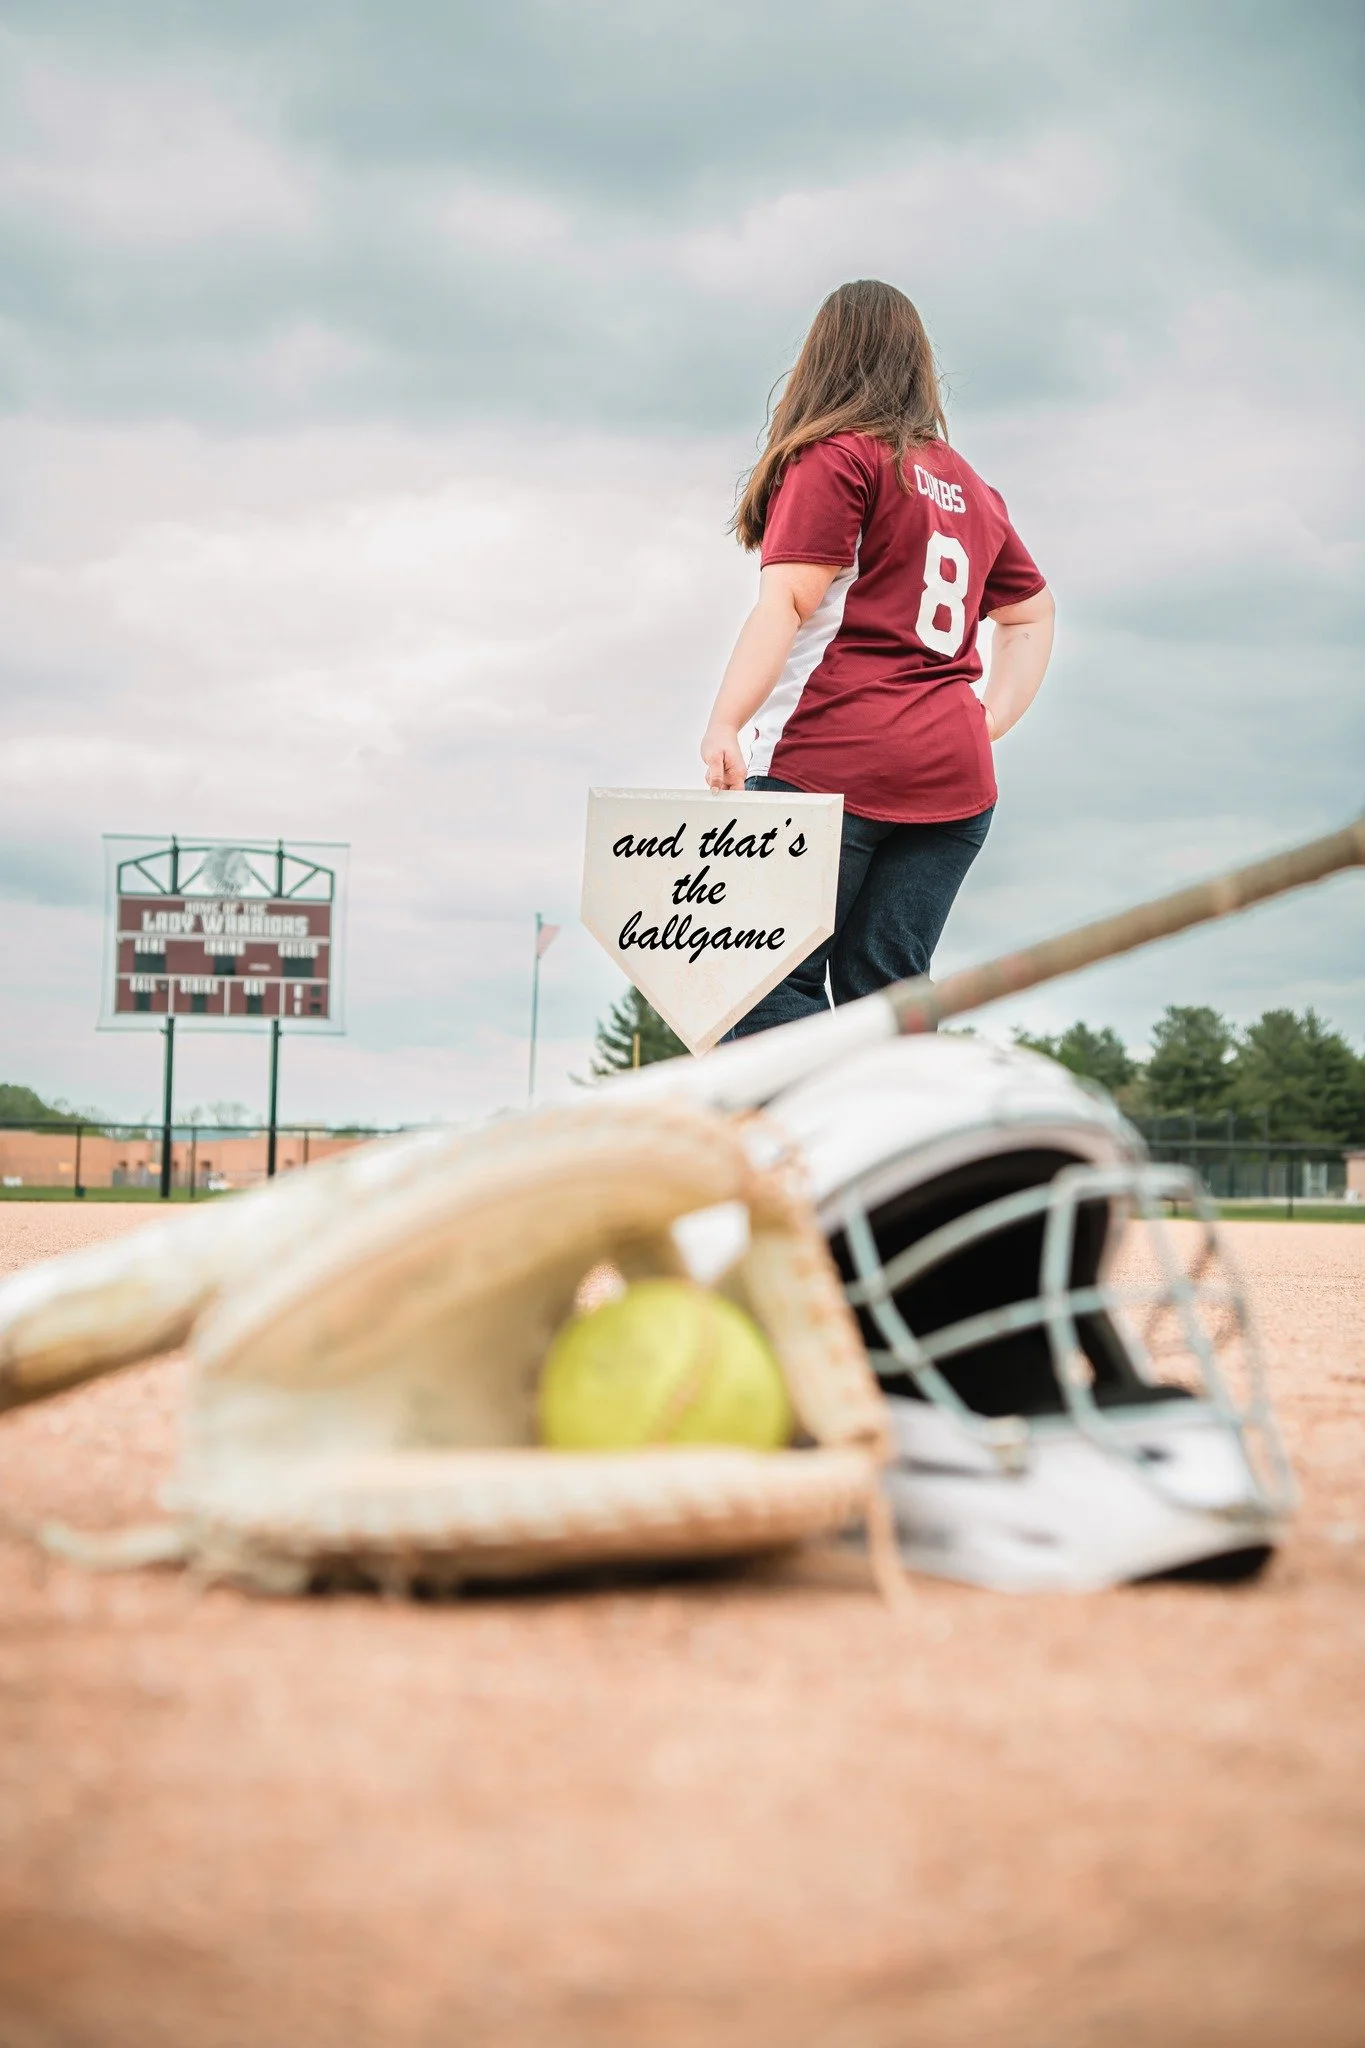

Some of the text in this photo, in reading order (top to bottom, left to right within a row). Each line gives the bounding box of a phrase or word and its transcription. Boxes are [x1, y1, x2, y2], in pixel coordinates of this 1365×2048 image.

[913, 464, 967, 514] COMBS
[915, 530, 970, 658] 8
[612, 817, 808, 858] and that's
[671, 865, 727, 905] the
[142, 910, 309, 937] LADY WARRIORS
[618, 910, 786, 964] ballgame
